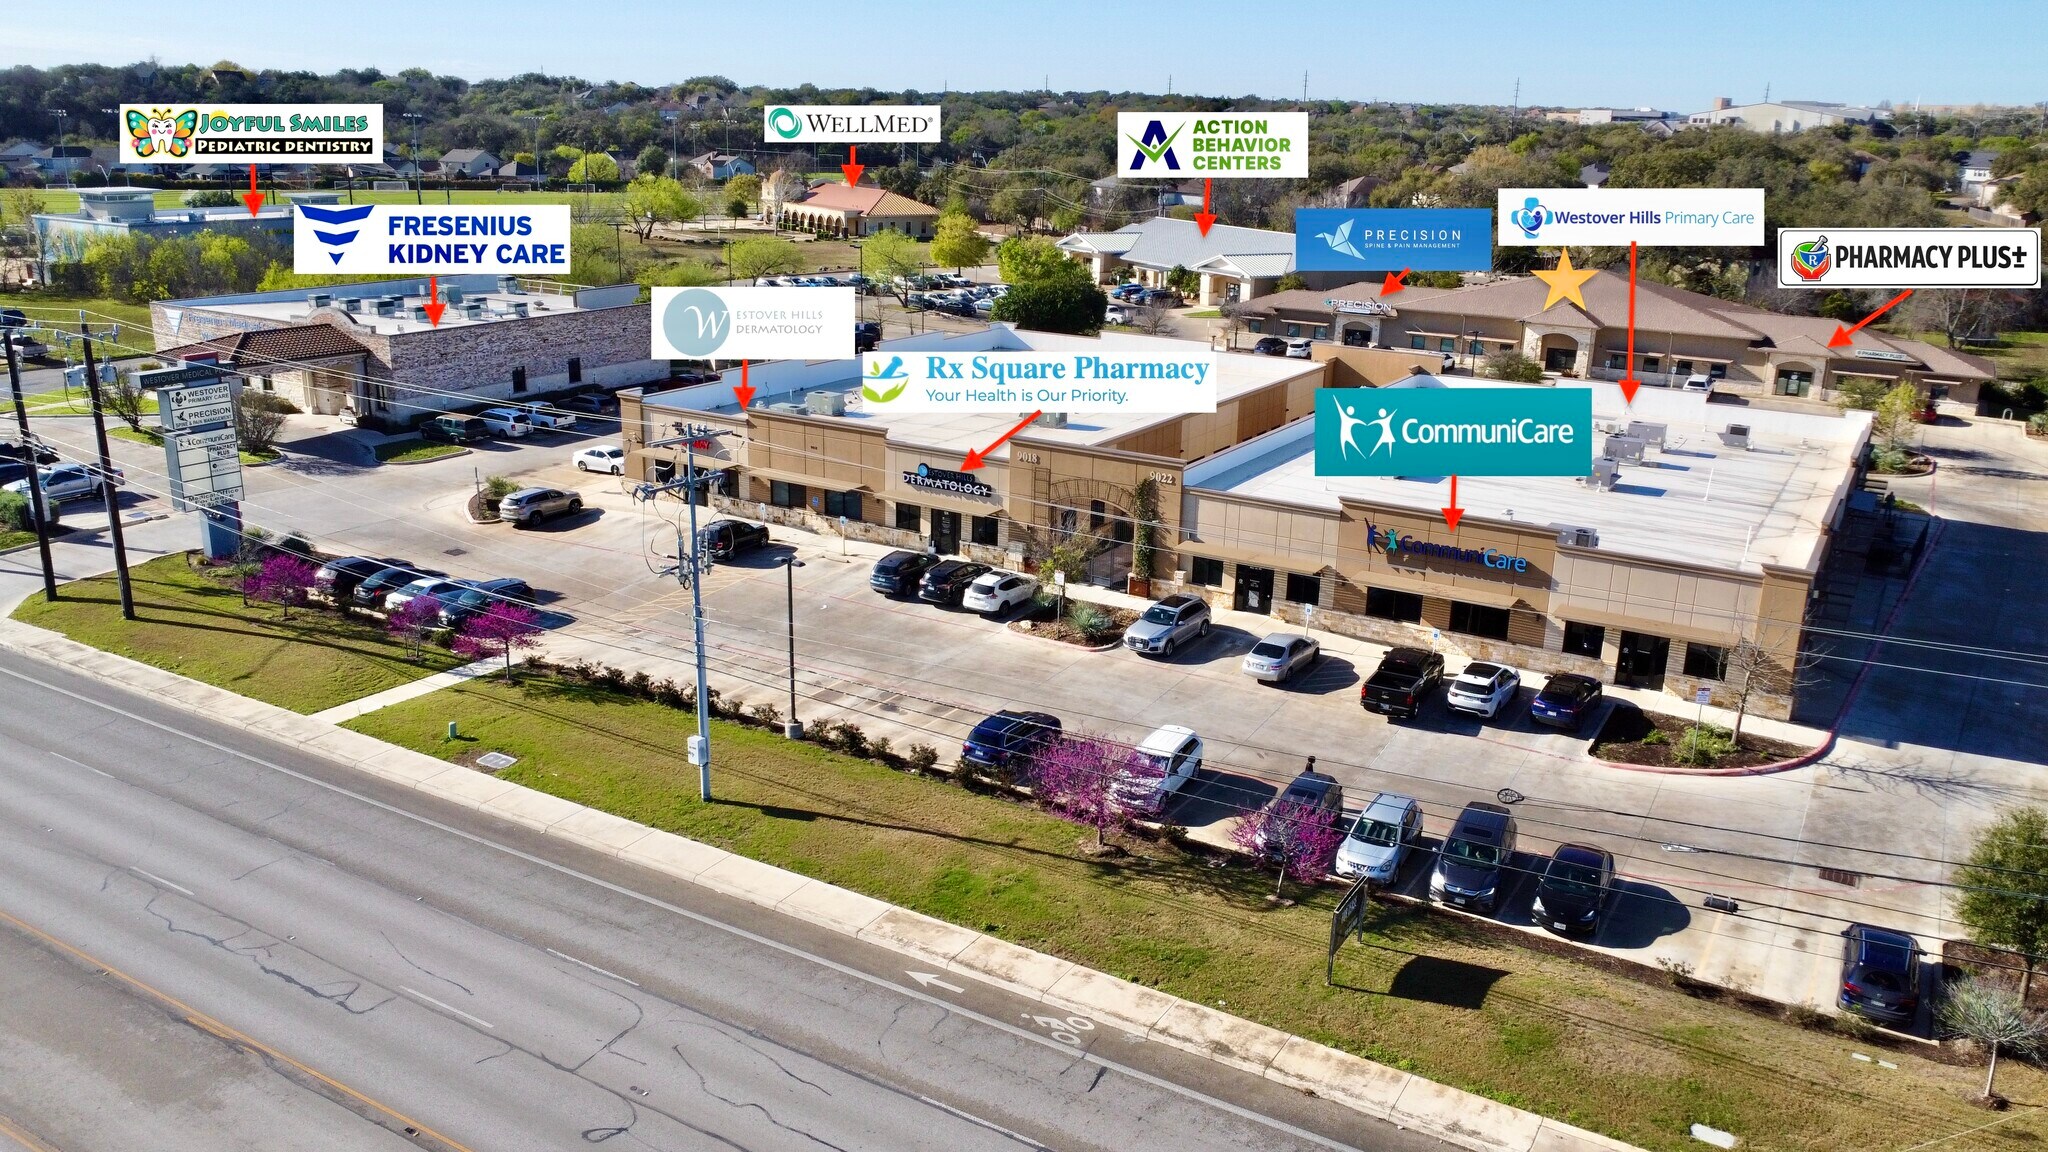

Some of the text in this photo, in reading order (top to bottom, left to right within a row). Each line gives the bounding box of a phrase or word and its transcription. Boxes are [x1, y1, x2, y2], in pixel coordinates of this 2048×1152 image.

[1331, 299, 1392, 311] PRECISION
[142, 373, 180, 385] WESTOVER
[181, 369, 213, 380] MEDICAL
[188, 386, 229, 397] WESTOVER
[189, 407, 231, 419] PRECISION
[217, 449, 230, 457] PLUS
[1017, 450, 1038, 463] 9018
[1149, 471, 1173, 484] 9022
[903, 473, 988, 496] DERMATOLOGY
[1400, 535, 1527, 573] CommuniCare
